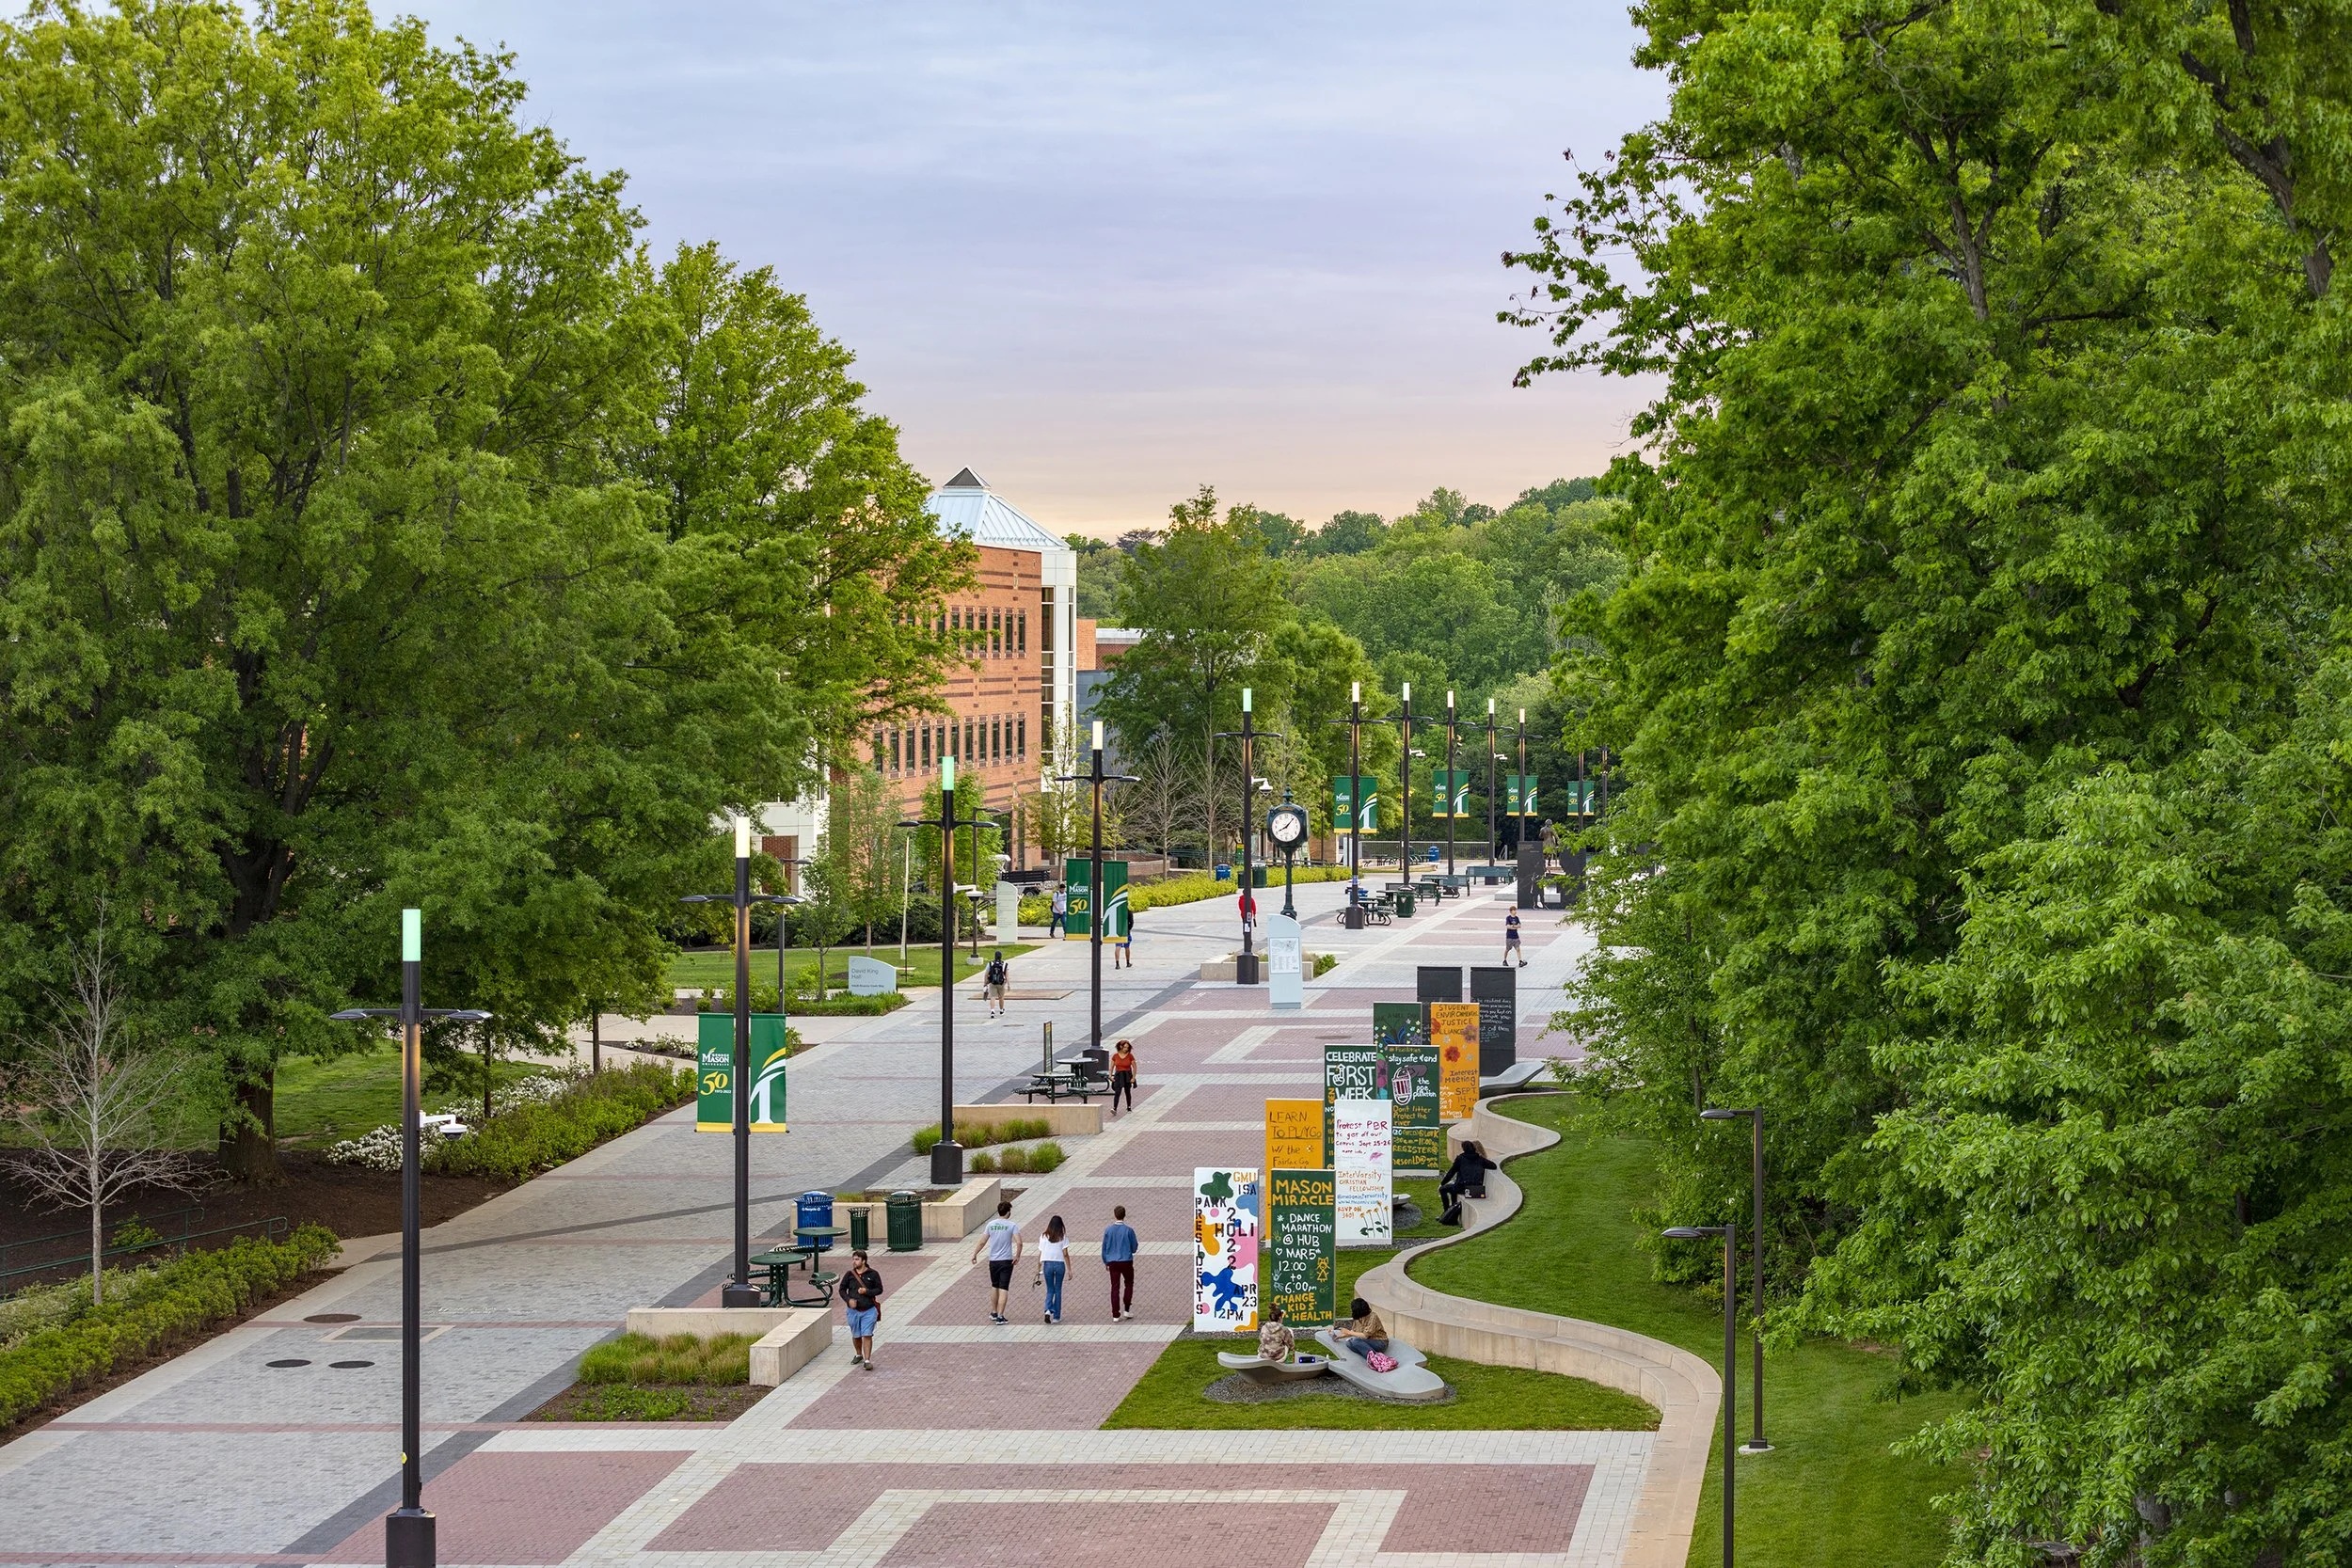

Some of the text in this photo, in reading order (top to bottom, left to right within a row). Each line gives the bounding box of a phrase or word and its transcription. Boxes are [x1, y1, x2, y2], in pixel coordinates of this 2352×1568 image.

[1336, 803, 1349, 816] 50
[1068, 898, 1088, 915] 50
[1441, 1018, 1473, 1026] JUSTICE
[702, 1053, 729, 1063] MASON
[1326, 1052, 1376, 1062] CELEBRATE
[1389, 1053, 1401, 1065] stay
[1402, 1053, 1418, 1062] safe
[700, 1071, 728, 1095] 50
[1445, 1076, 1476, 1086] Meeting
[1336, 1087, 1373, 1100] WEEK
[1460, 1104, 1467, 1113] 7
[1270, 1111, 1307, 1123] LEARN
[1337, 1119, 1362, 1130] Protest
[1367, 1120, 1388, 1130] PBR
[1271, 1126, 1285, 1137] To
[1288, 1126, 1310, 1138] PLAY
[1347, 1132, 1359, 1140] get
[1271, 1145, 1300, 1155] W/ the
[1273, 1157, 1309, 1167] Fairfax Go
[1233, 1172, 1257, 1182] GMU
[1238, 1184, 1256, 1196] ISA
[1276, 1180, 1332, 1195] MASON
[1195, 1197, 1227, 1208] PARK
[1272, 1194, 1334, 1206] MIRACLE
[1289, 1213, 1320, 1223] DANCE
[1215, 1223, 1254, 1237] HOLI
[1281, 1223, 1332, 1233] MARATHON
[1282, 1233, 1320, 1246] @ HUB
[1286, 1248, 1308, 1259] MAR
[1279, 1260, 1307, 1271] 12:00
[1290, 1273, 1302, 1282] to
[1233, 1284, 1257, 1294] APR
[1242, 1296, 1257, 1307] 23
[1274, 1292, 1315, 1306] CHANGE
[1214, 1308, 1244, 1321] 12PM
[1292, 1310, 1332, 1322] HEALTH
